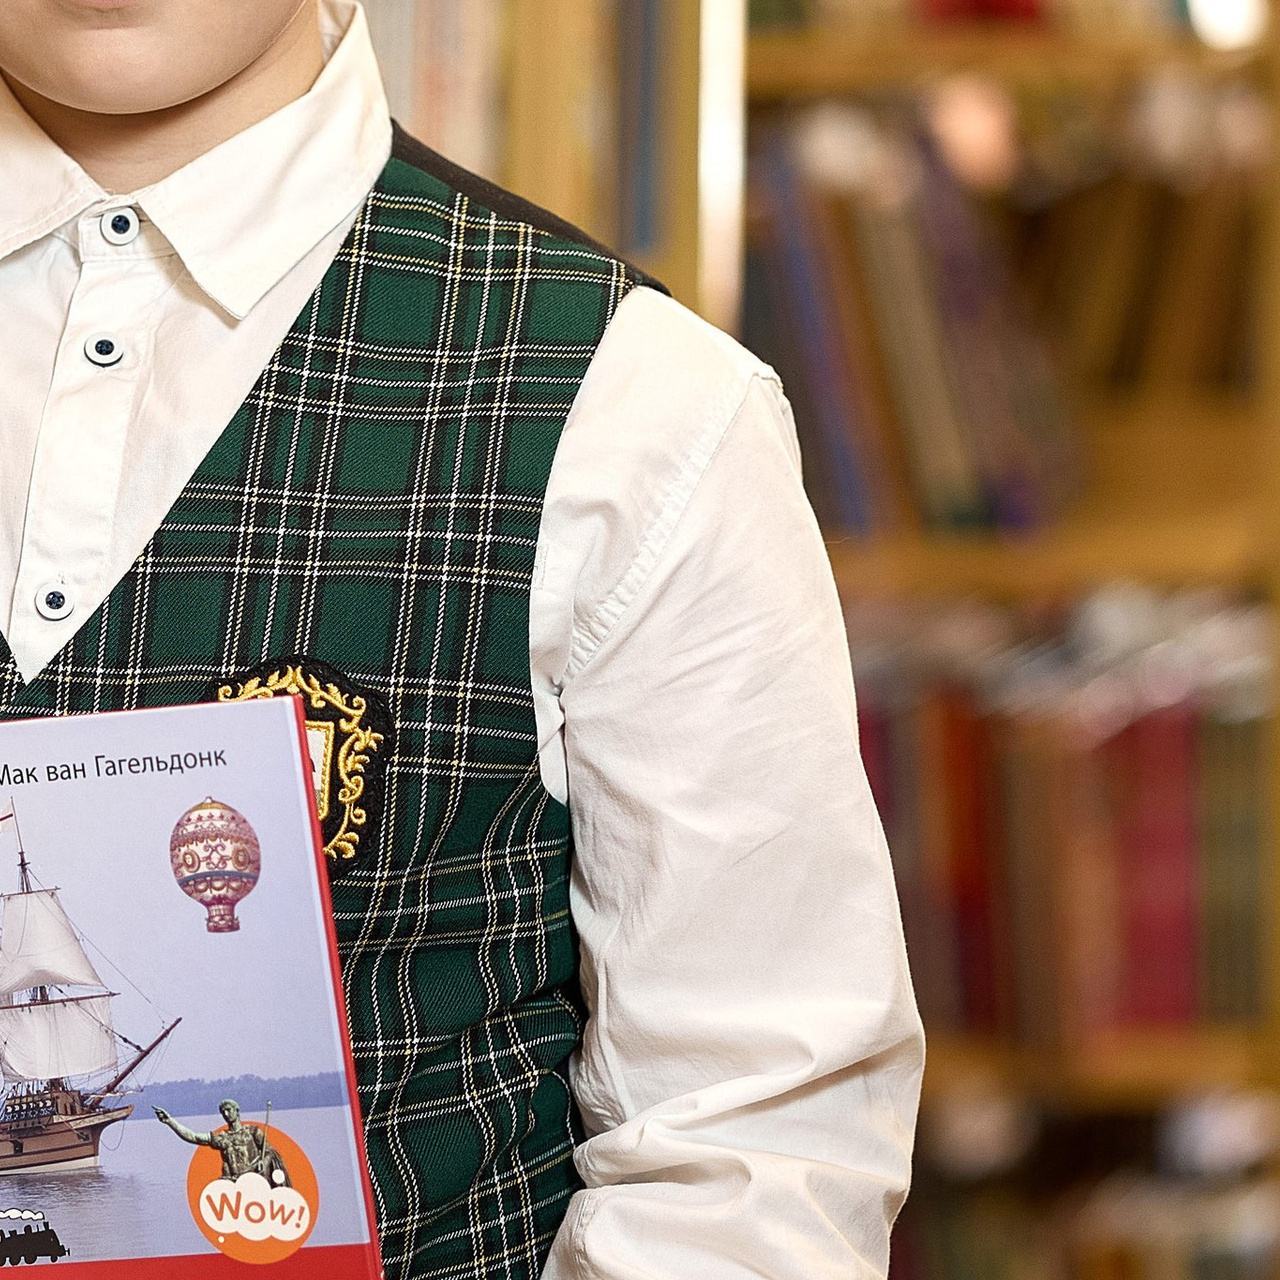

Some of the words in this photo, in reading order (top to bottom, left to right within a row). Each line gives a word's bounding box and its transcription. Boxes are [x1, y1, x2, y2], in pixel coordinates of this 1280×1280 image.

[45, 761, 87, 783] ван
[94, 749, 228, 778] Гагельдонк
[205, 1190, 306, 1229] Wow!
